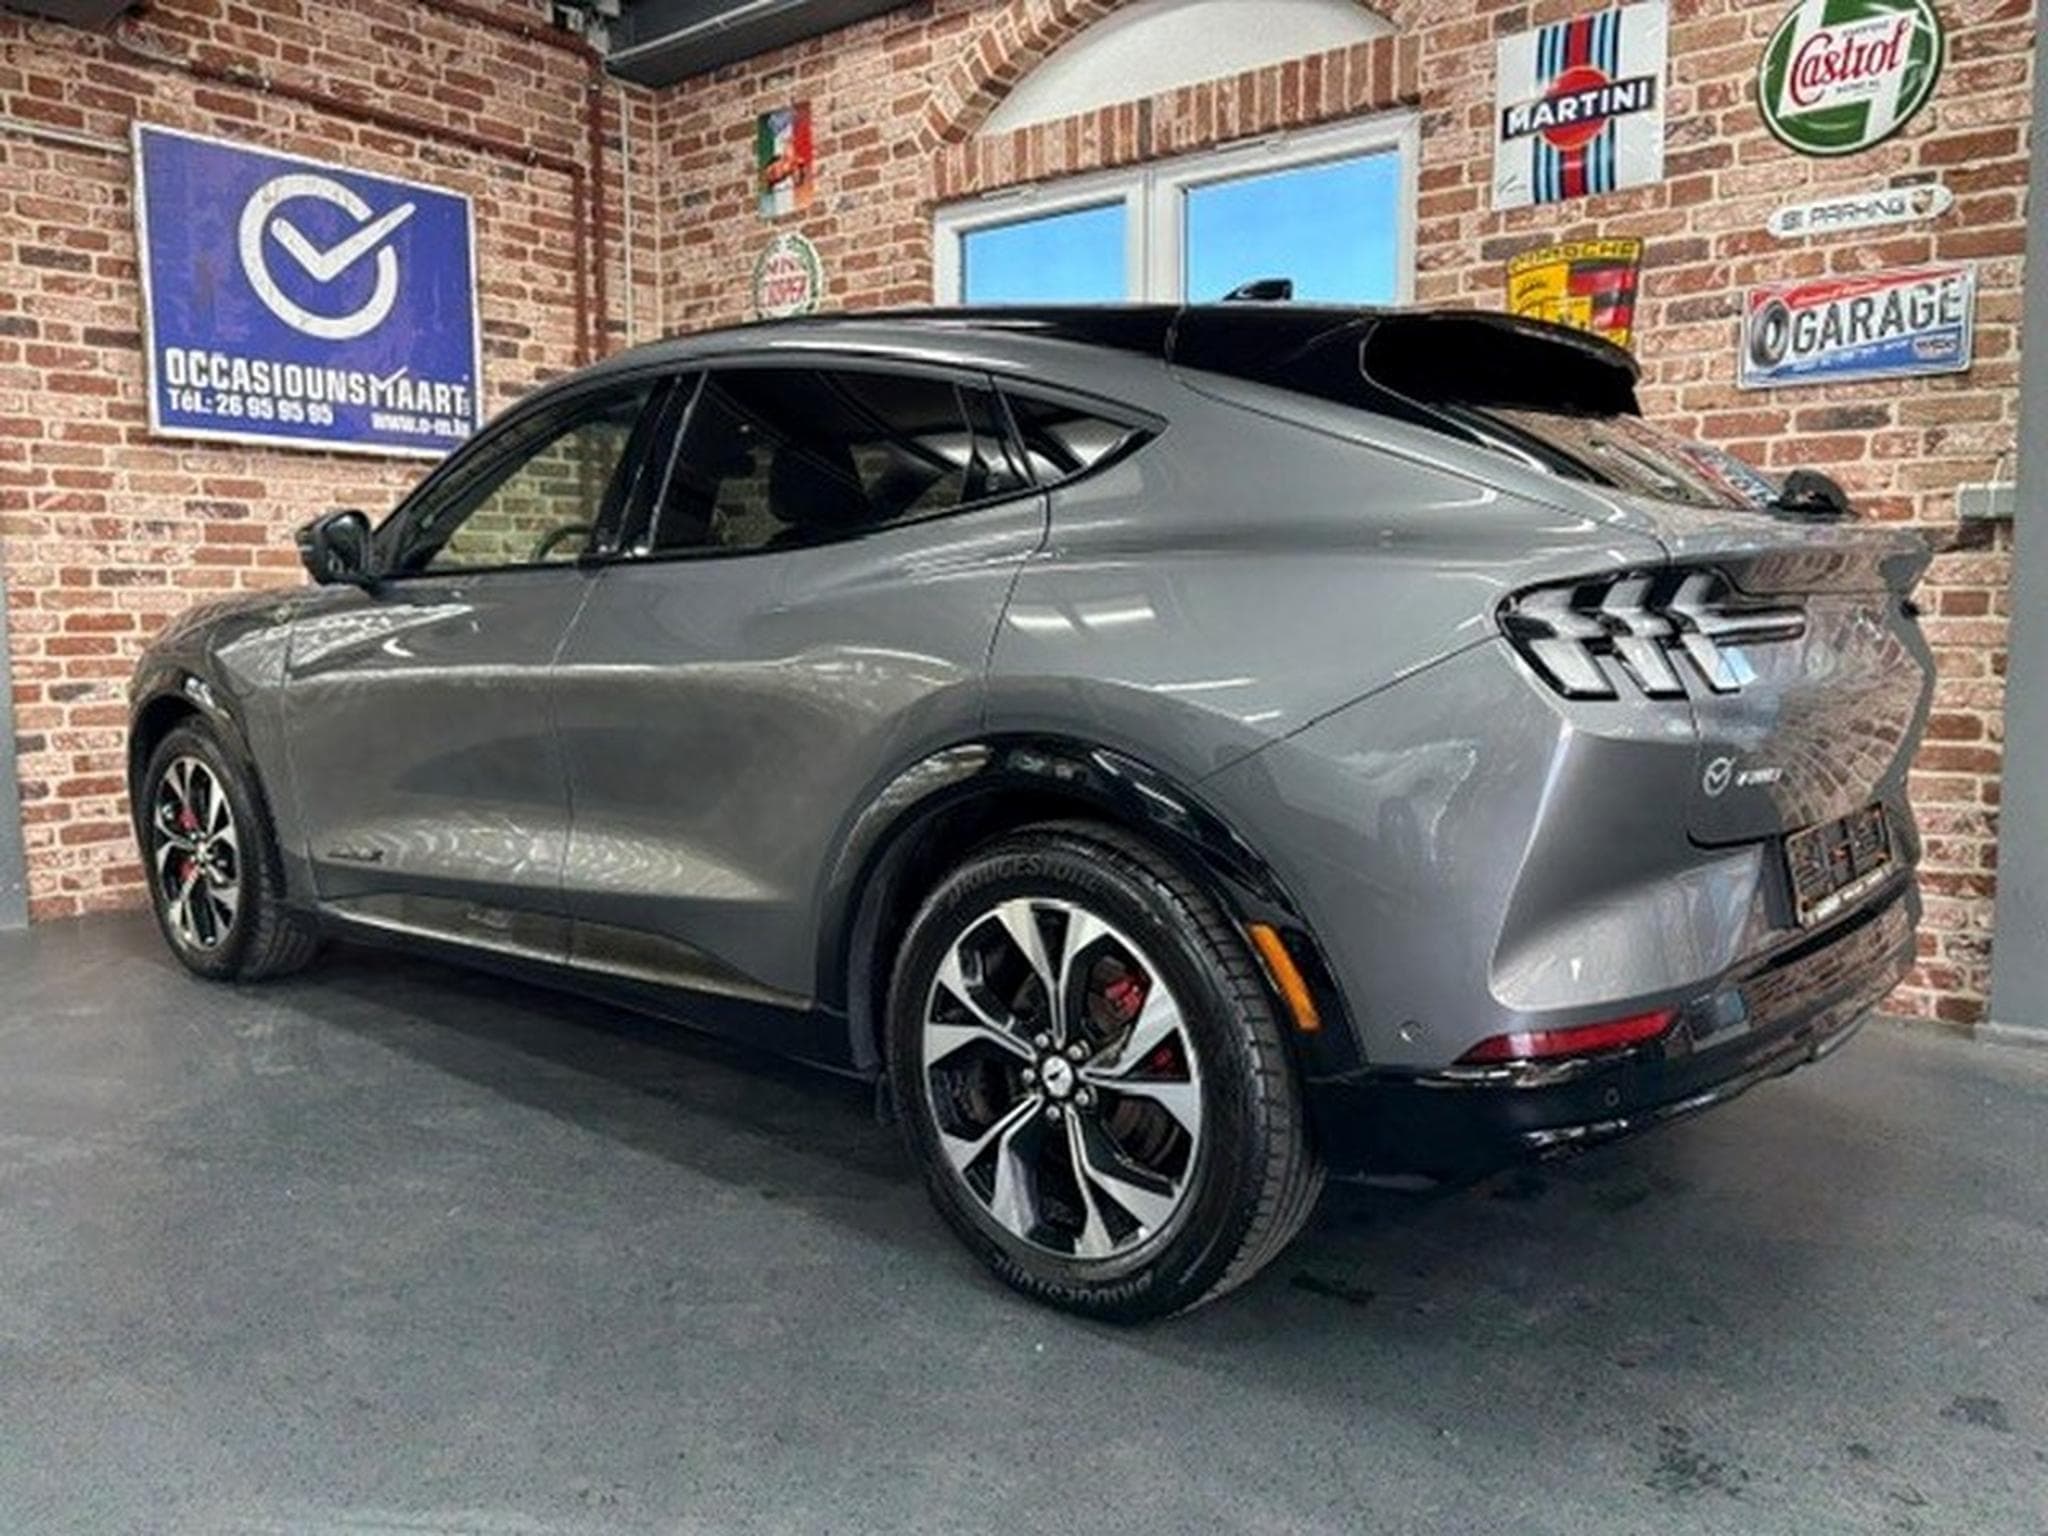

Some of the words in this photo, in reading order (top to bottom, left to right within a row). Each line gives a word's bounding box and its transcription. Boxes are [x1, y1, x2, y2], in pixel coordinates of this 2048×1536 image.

[1790, 18, 1909, 107] Castrol
[1507, 81, 1648, 135] MARTINI
[1793, 277, 1963, 354] GARAGE
[216, 393, 244, 417] 26
[246, 396, 274, 420] 95
[278, 399, 304, 423] 95
[307, 402, 334, 427] 95
